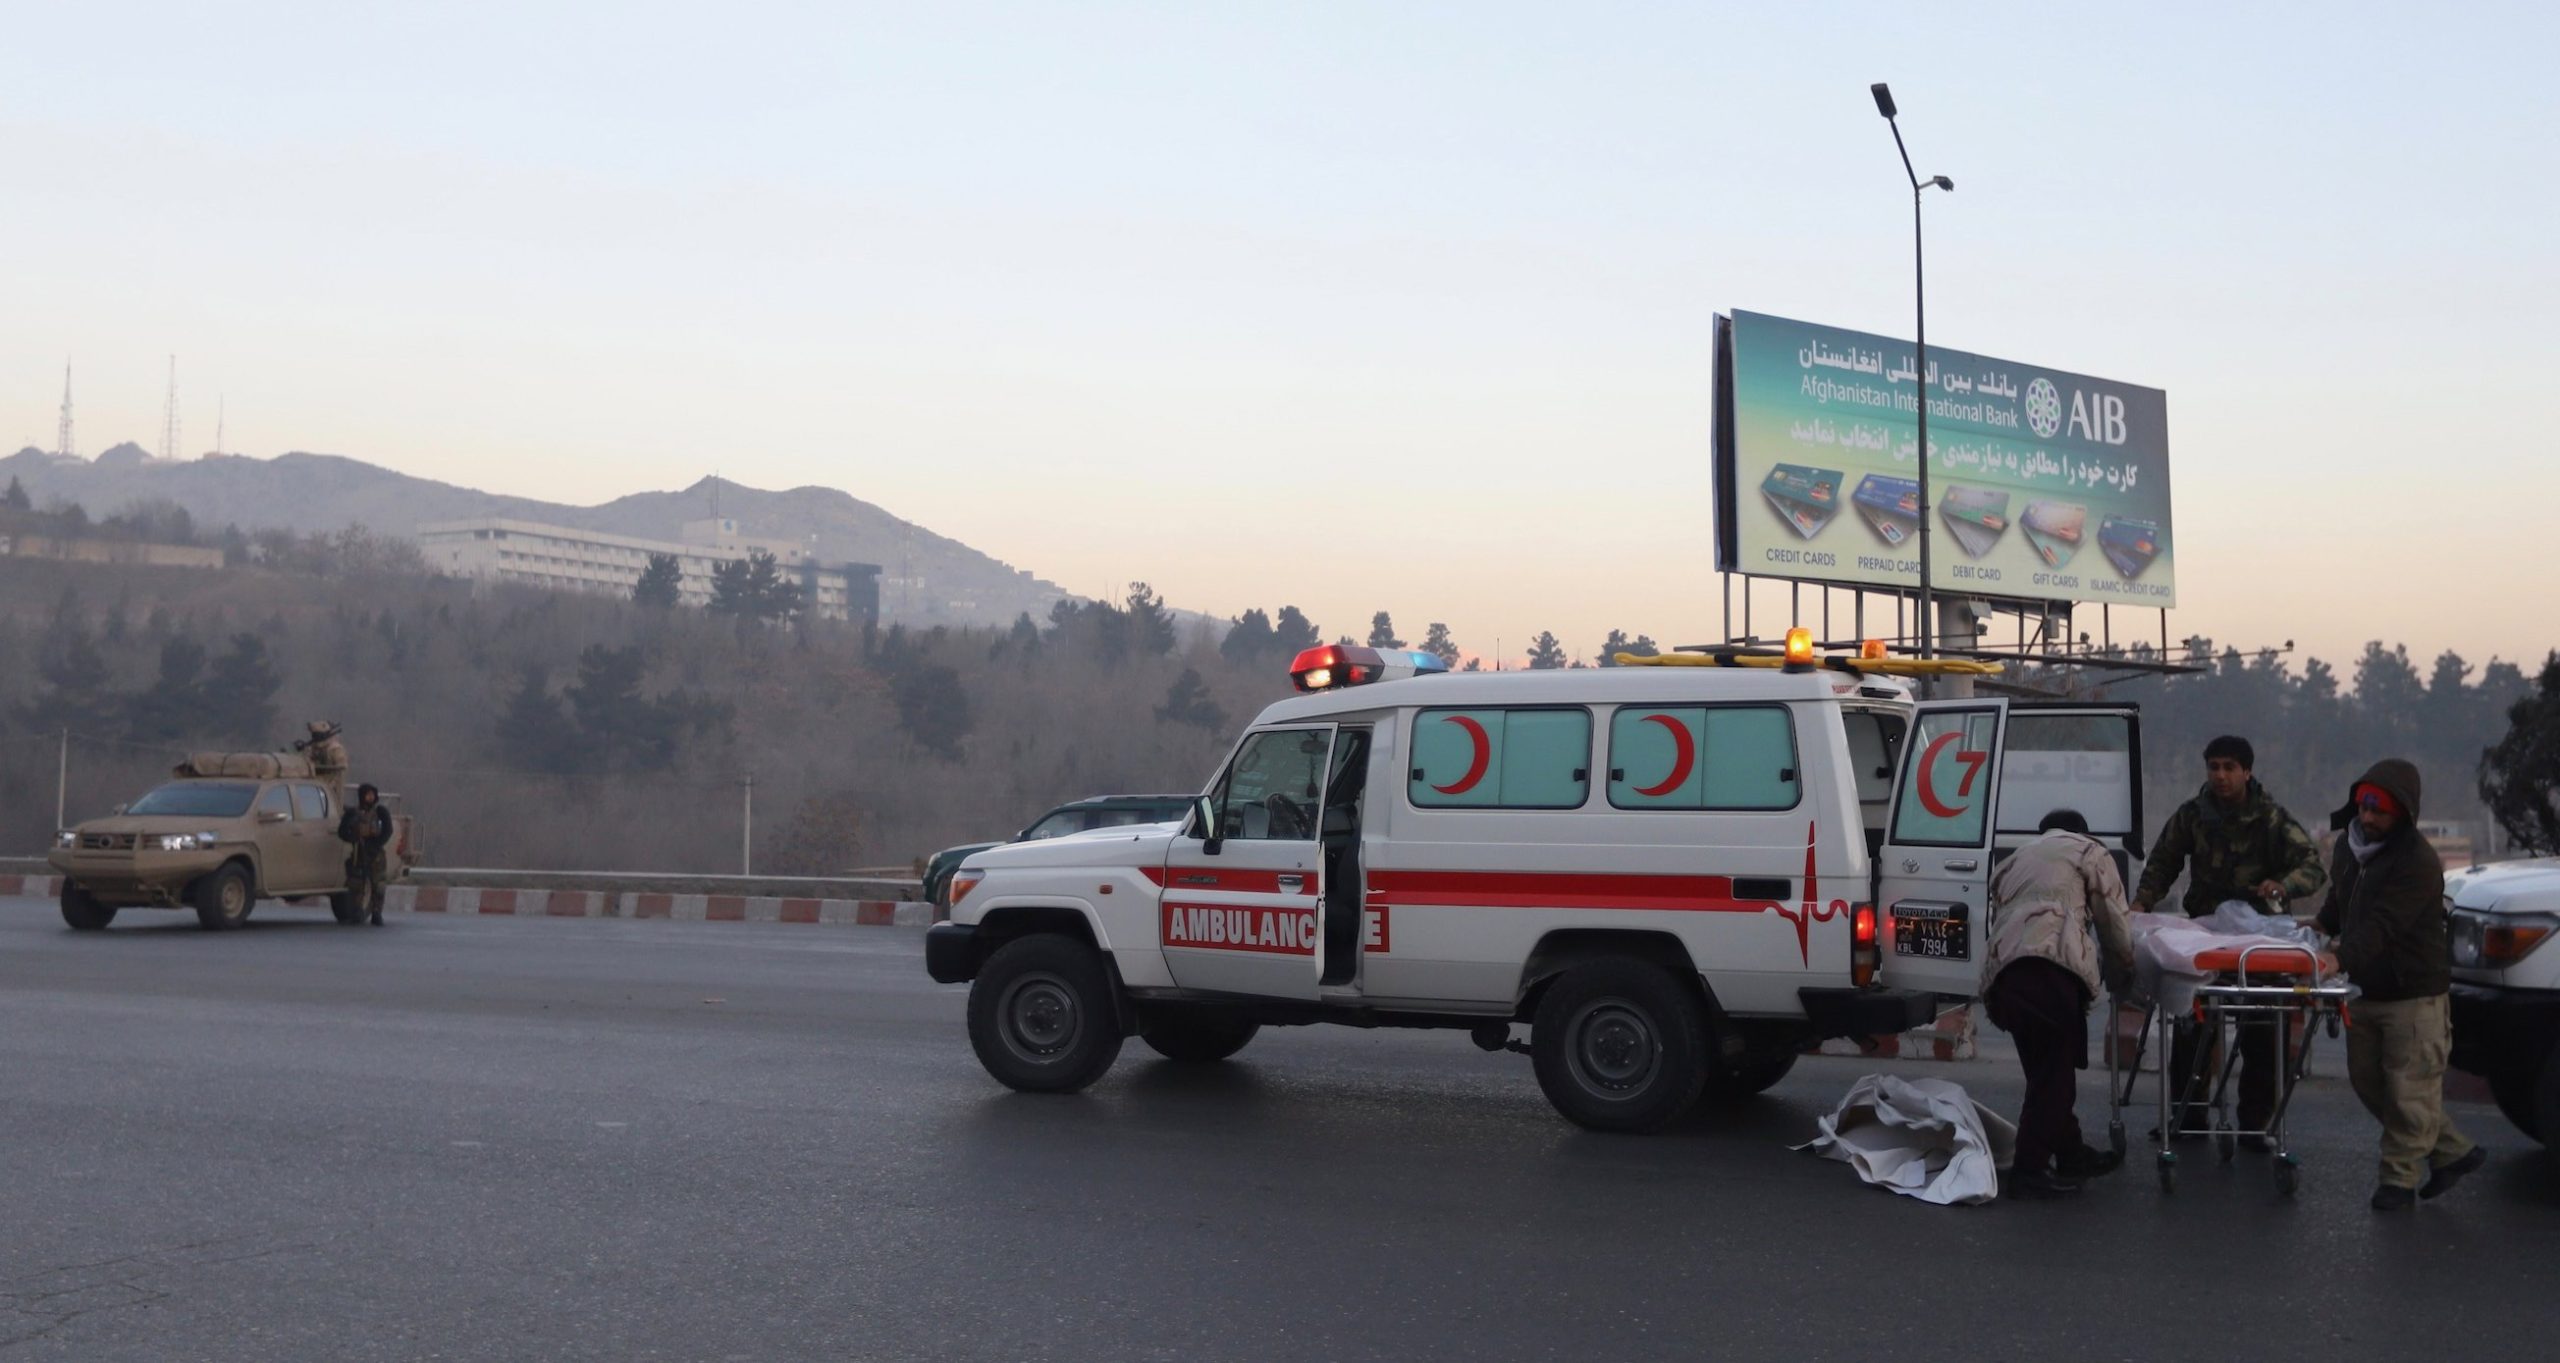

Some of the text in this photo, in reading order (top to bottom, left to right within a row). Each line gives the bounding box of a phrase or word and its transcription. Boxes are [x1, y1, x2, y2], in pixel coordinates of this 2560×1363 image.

[1799, 339, 1883, 375] افغانستان
[1800, 374, 2019, 429] Afghanistan Intenational Bank
[2067, 388, 2127, 445] AIB
[1892, 431, 1939, 462] خیش
[1766, 548, 1836, 567] CREDIT CARDS
[1858, 556, 1895, 572] PREPAID
[1953, 565, 2001, 581] DEBIT CARD
[2033, 572, 2080, 589] GIFT CARDS
[2090, 578, 2170, 597] ISLAMIC CREDIT CARD
[1955, 751, 1987, 797] 7
[1896, 907, 1928, 917] TOYOTA
[1896, 938, 1948, 956] KBL 7994
